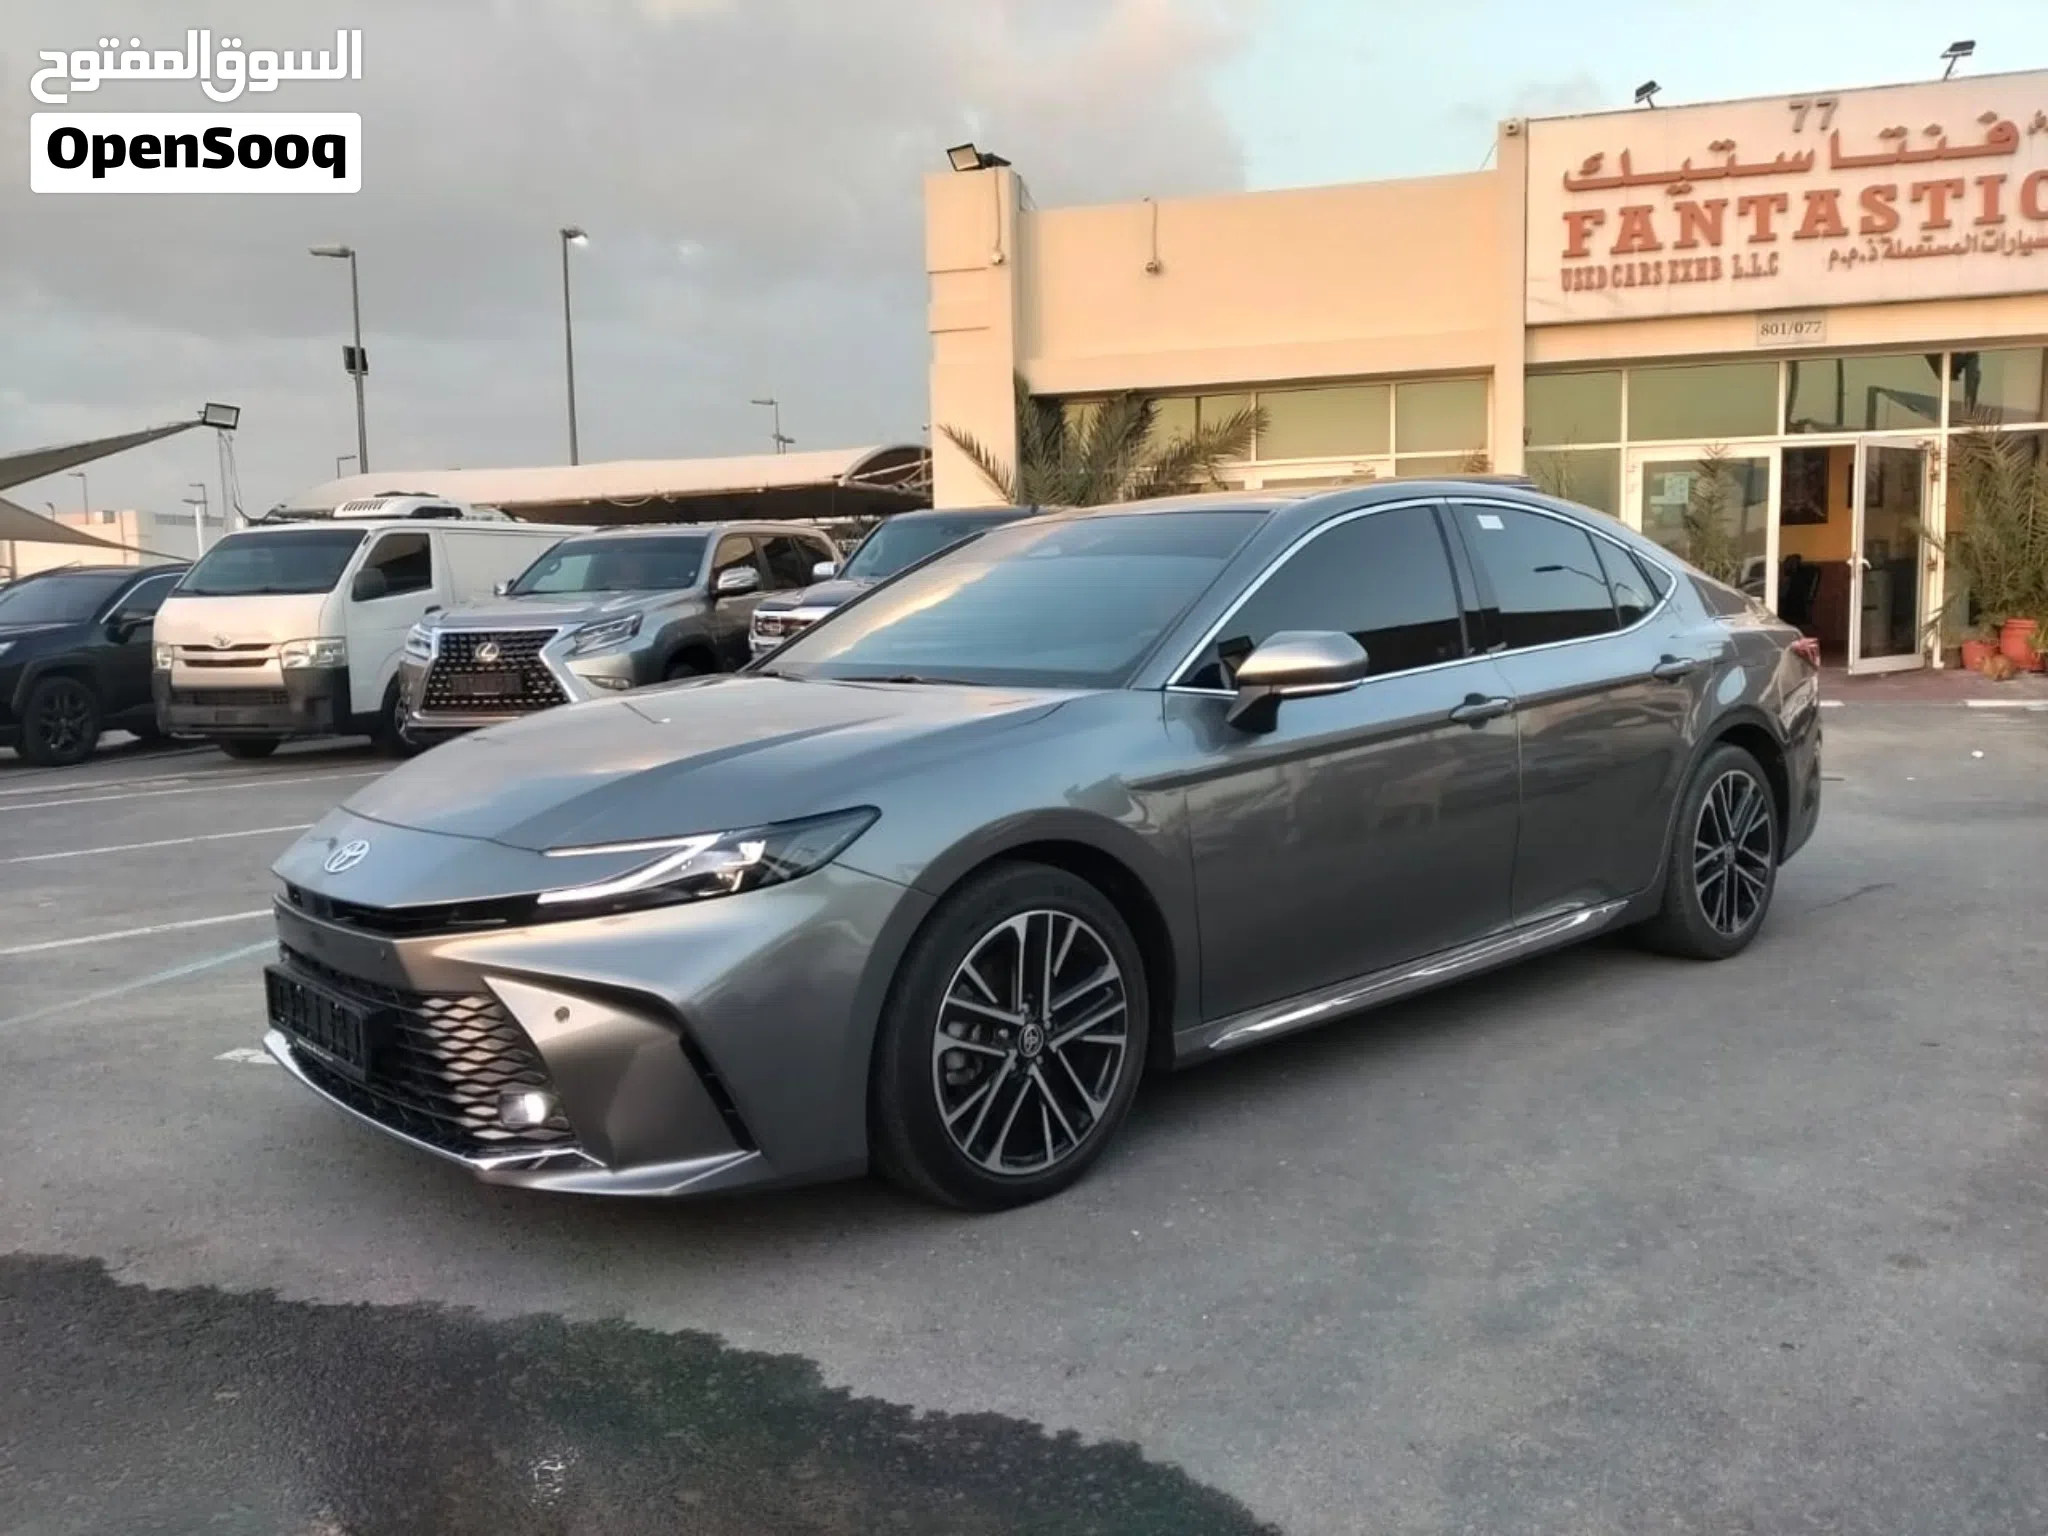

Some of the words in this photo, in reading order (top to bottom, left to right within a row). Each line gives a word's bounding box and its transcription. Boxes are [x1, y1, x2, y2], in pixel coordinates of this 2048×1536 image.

[1788, 99, 1839, 133] 77
[1562, 169, 2048, 258] FANTASTIC
[1561, 264, 1607, 292] USED
[1611, 260, 1663, 288] CARS
[1760, 320, 1823, 337] 801/077
